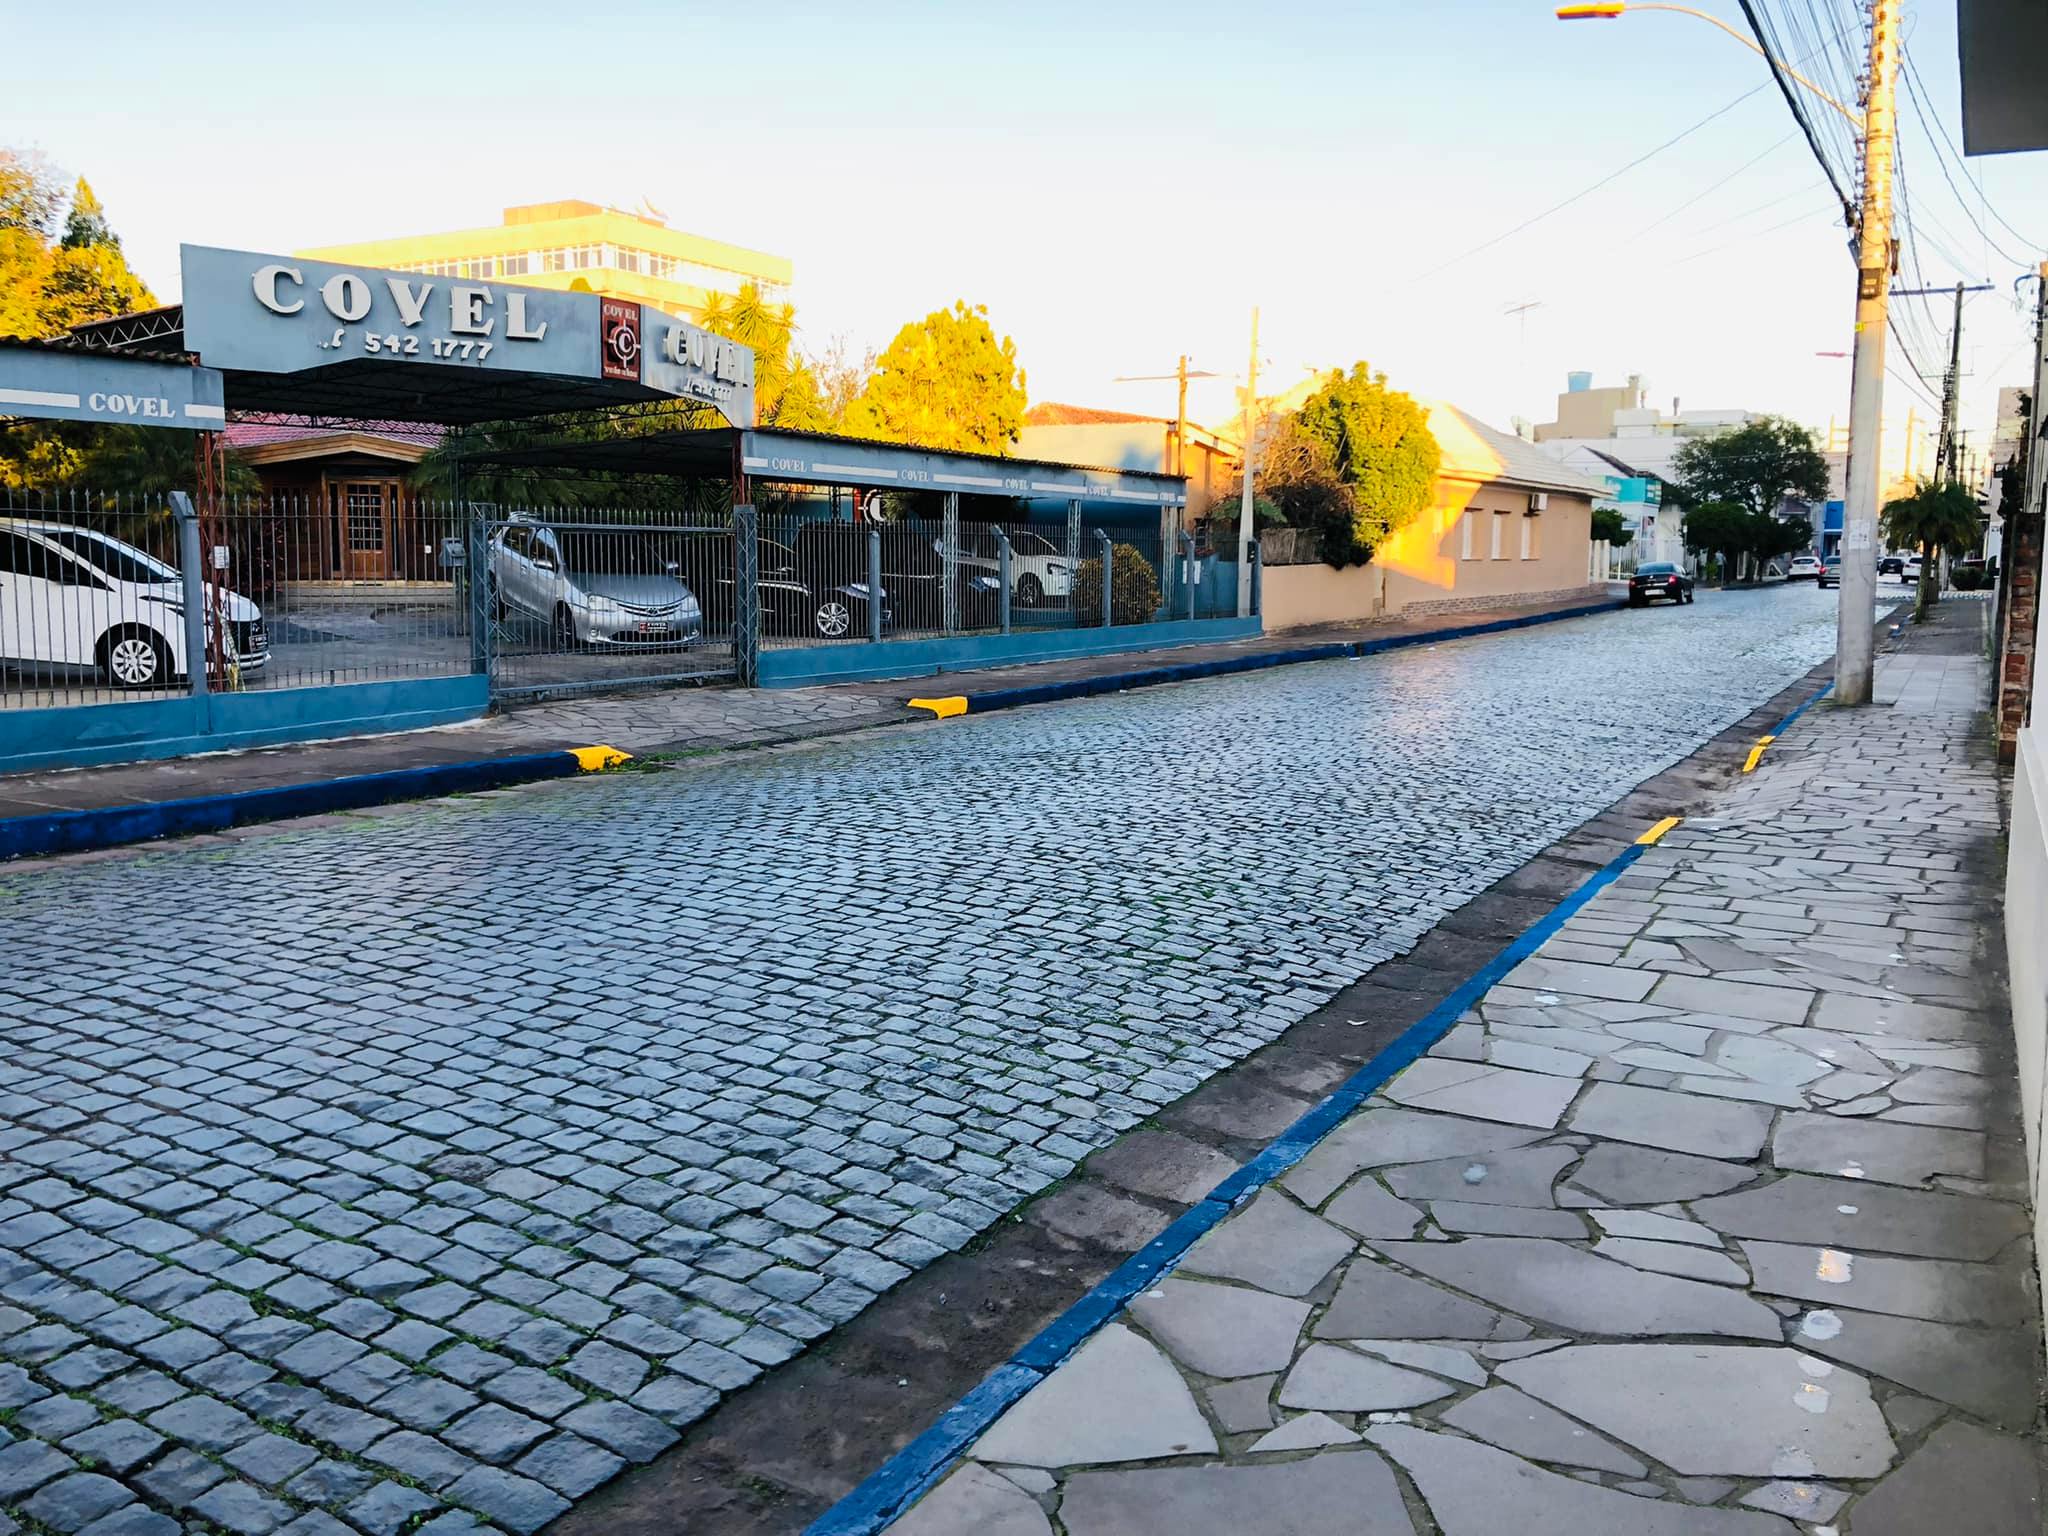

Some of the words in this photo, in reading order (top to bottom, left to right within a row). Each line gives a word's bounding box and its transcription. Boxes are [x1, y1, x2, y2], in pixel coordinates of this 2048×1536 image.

[252, 264, 547, 341] COVEL
[604, 304, 638, 321] COVEL
[365, 331, 419, 354] 542
[431, 338, 493, 360] 1777
[89, 391, 176, 418] COVEL
[772, 458, 807, 473] COVEL
[901, 469, 929, 482] COVEL
[1005, 478, 1029, 490] COVEL
